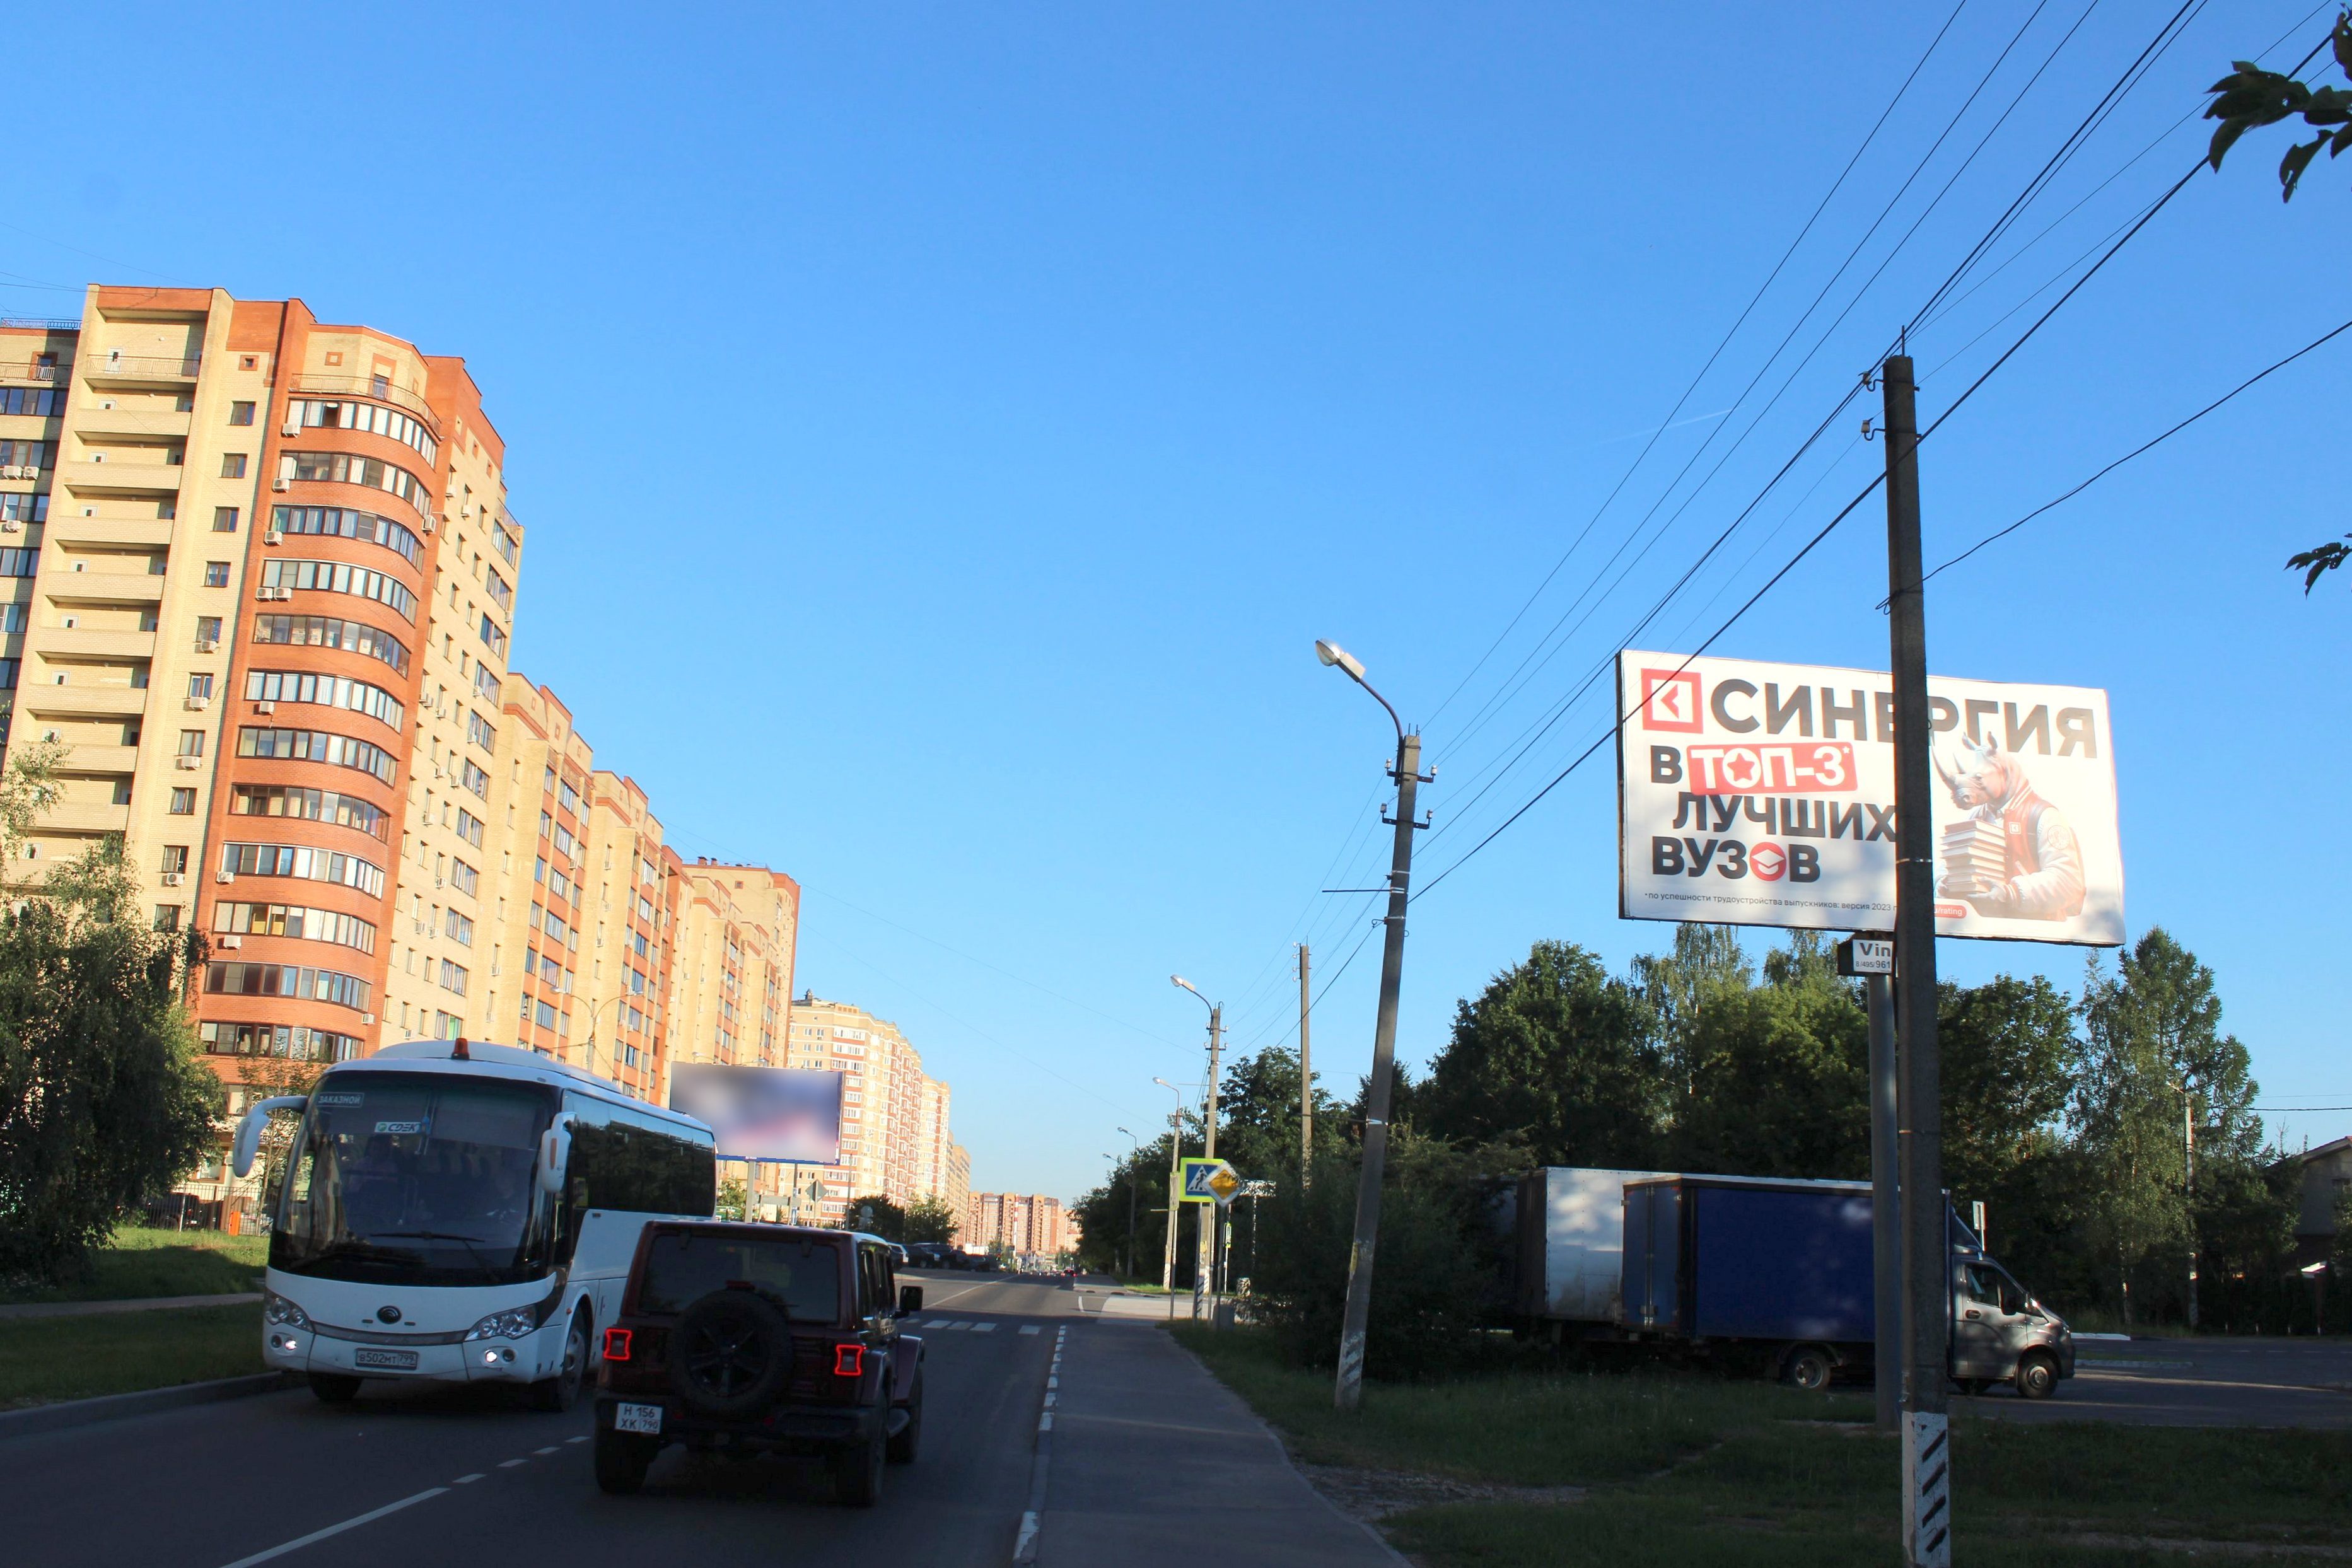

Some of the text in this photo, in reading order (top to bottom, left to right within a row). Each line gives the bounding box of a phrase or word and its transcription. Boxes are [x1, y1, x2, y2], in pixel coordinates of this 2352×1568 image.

[1650, 745, 1682, 784] В
[1673, 792, 1895, 842] ЛУЧШИХ
[1652, 836, 1820, 883] ВУЗОВ
[1660, 893, 1711, 902] успешности
[1713, 895, 1783, 905] трудоустройства
[1784, 898, 1840, 909] выпускников:
[1841, 902, 1870, 910] версия
[1872, 902, 1892, 912] 2023
[318, 1095, 361, 1104] ЗАКАЗНОЙ
